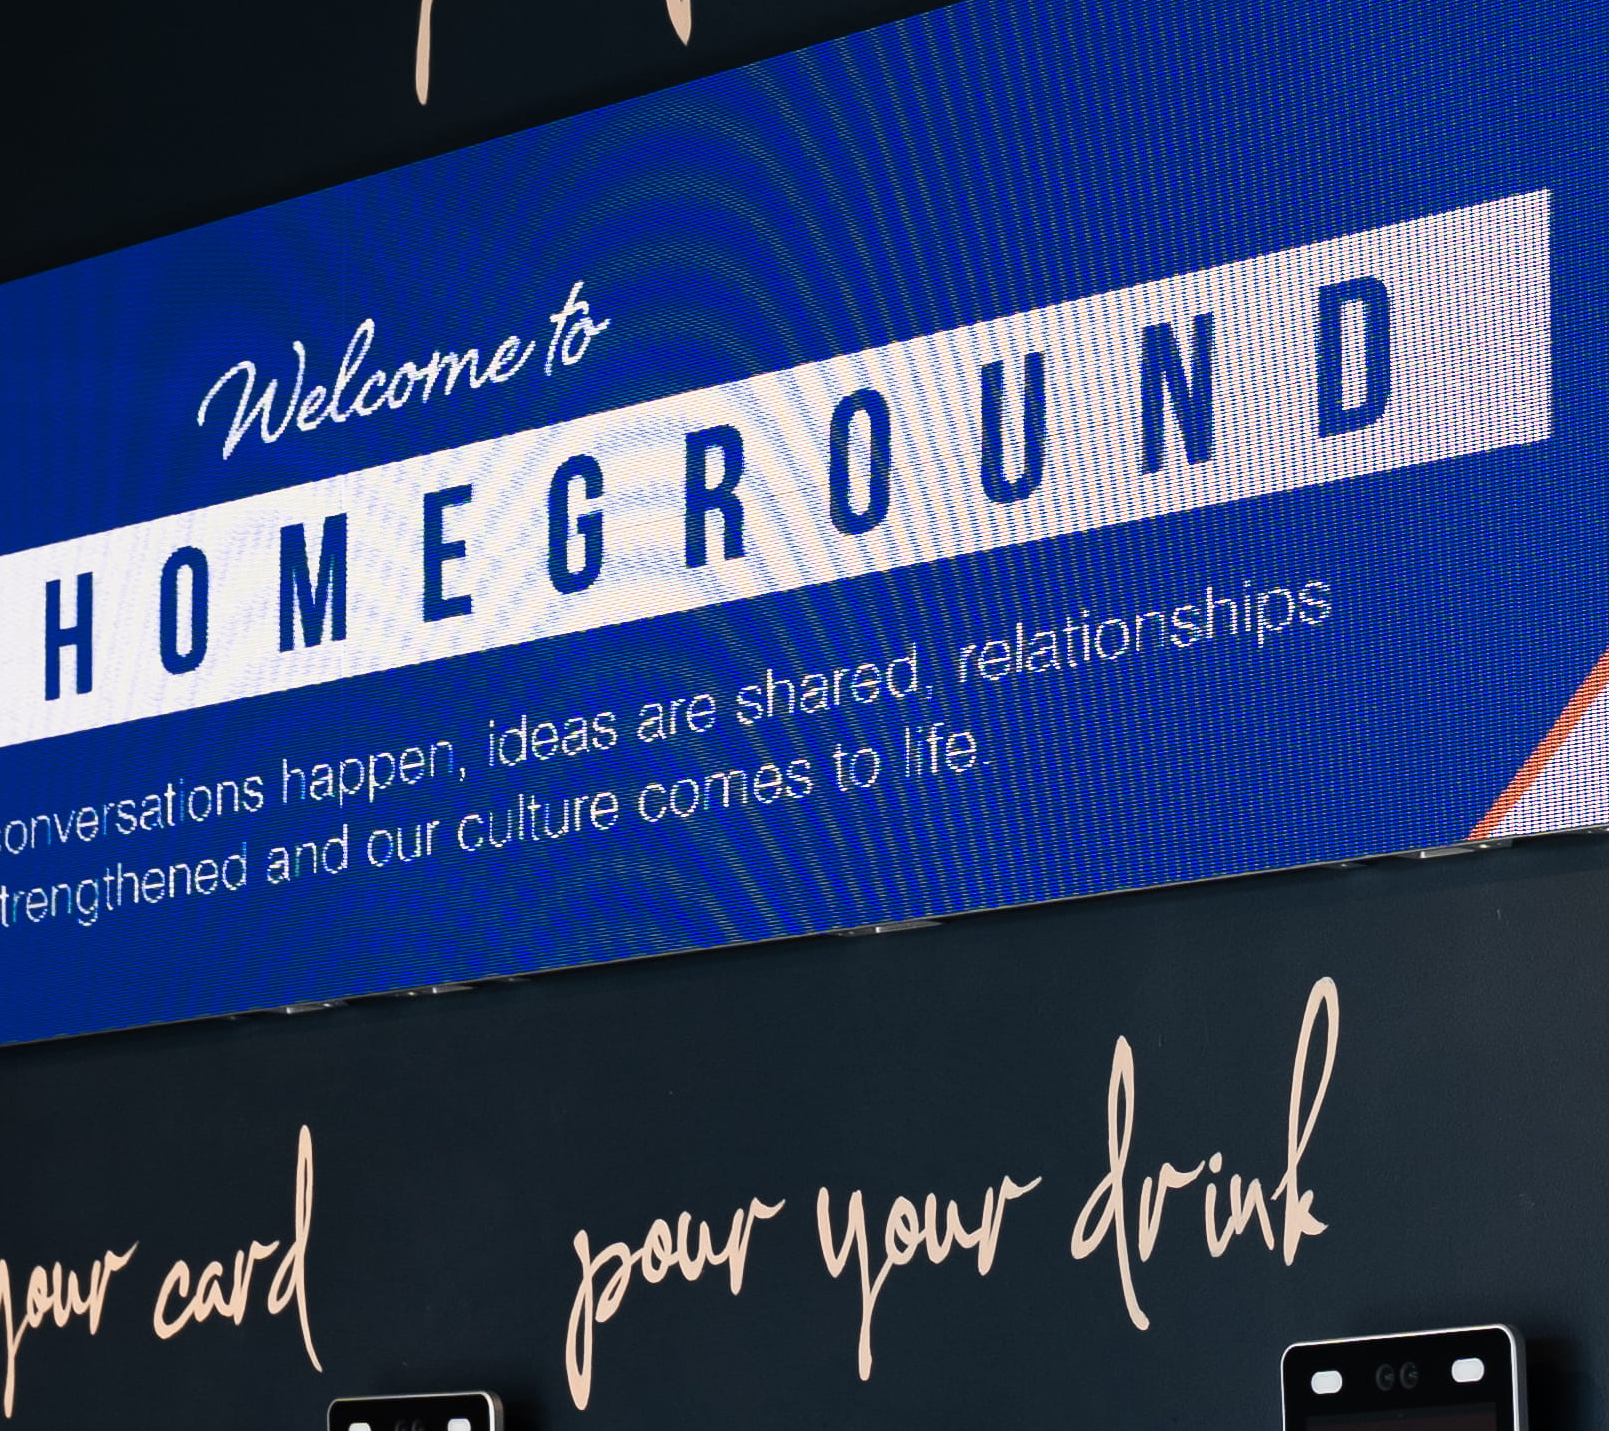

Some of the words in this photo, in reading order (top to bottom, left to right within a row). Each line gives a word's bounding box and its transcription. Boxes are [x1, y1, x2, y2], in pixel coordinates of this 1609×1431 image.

[44, 275, 1392, 702] HOMEGROUND
[197, 317, 536, 460] Welcome
[544, 280, 611, 377] to
[266, 823, 349, 884] and
[366, 817, 440, 868] our
[457, 790, 619, 852] culture
[638, 757, 814, 823] comes
[832, 743, 881, 792] to
[904, 721, 991, 779] life.
[281, 739, 466, 809] happen,
[487, 709, 618, 767] ideas
[636, 692, 718, 743] are
[735, 641, 933, 726] shared,
[957, 579, 1332, 684] relationships
[153, 1125, 323, 1372] card
[565, 1198, 786, 1411] pour
[816, 1175, 1042, 1381] your
[1071, 977, 1340, 1331] drink
